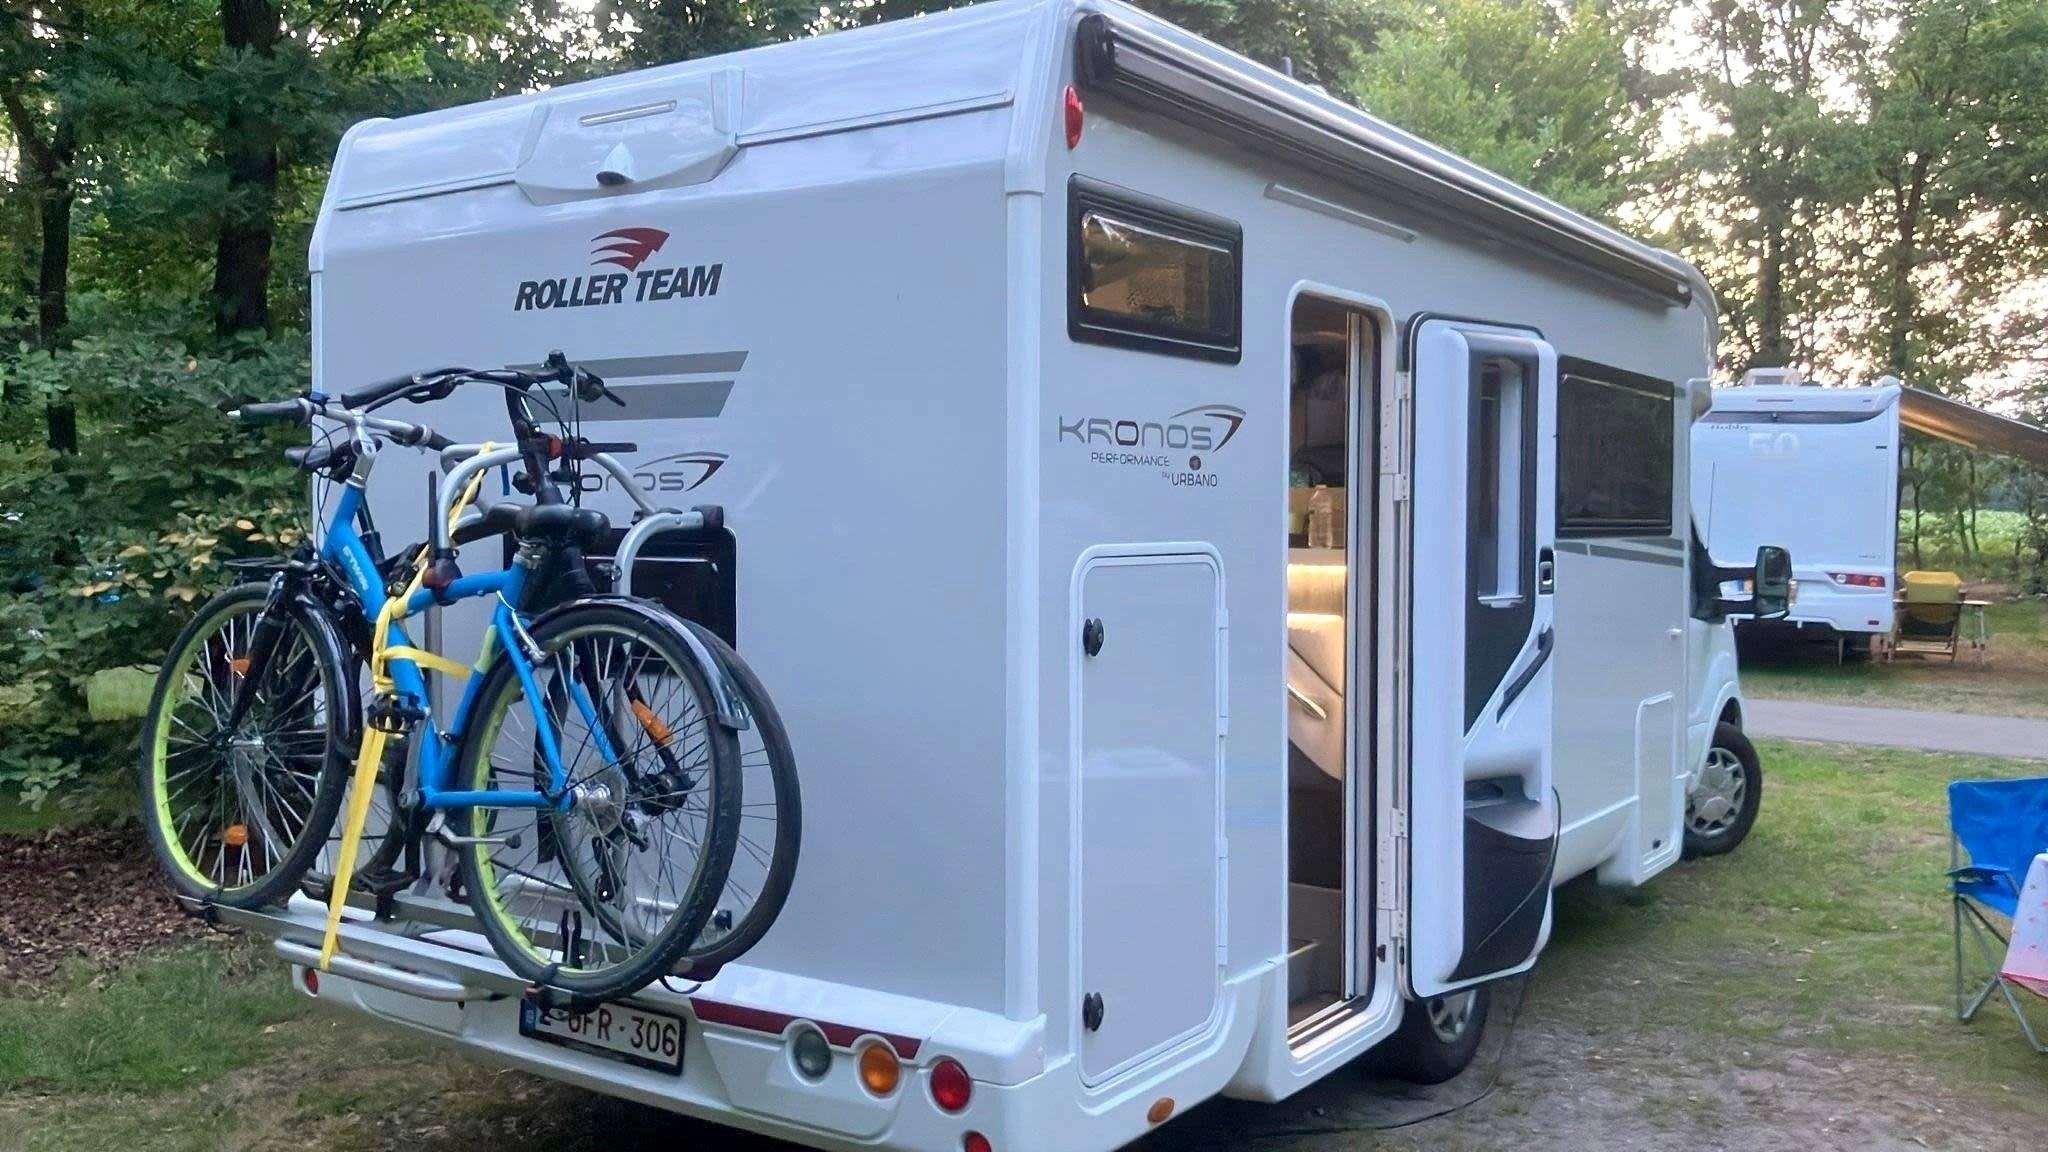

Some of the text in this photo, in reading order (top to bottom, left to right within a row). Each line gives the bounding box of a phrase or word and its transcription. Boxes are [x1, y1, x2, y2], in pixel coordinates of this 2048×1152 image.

[513, 263, 723, 311] ROLLER TEAM
[1058, 414, 1213, 451] KRONOS
[1091, 452, 1170, 467] PERFORMANCE
[1171, 472, 1218, 487] URBANO
